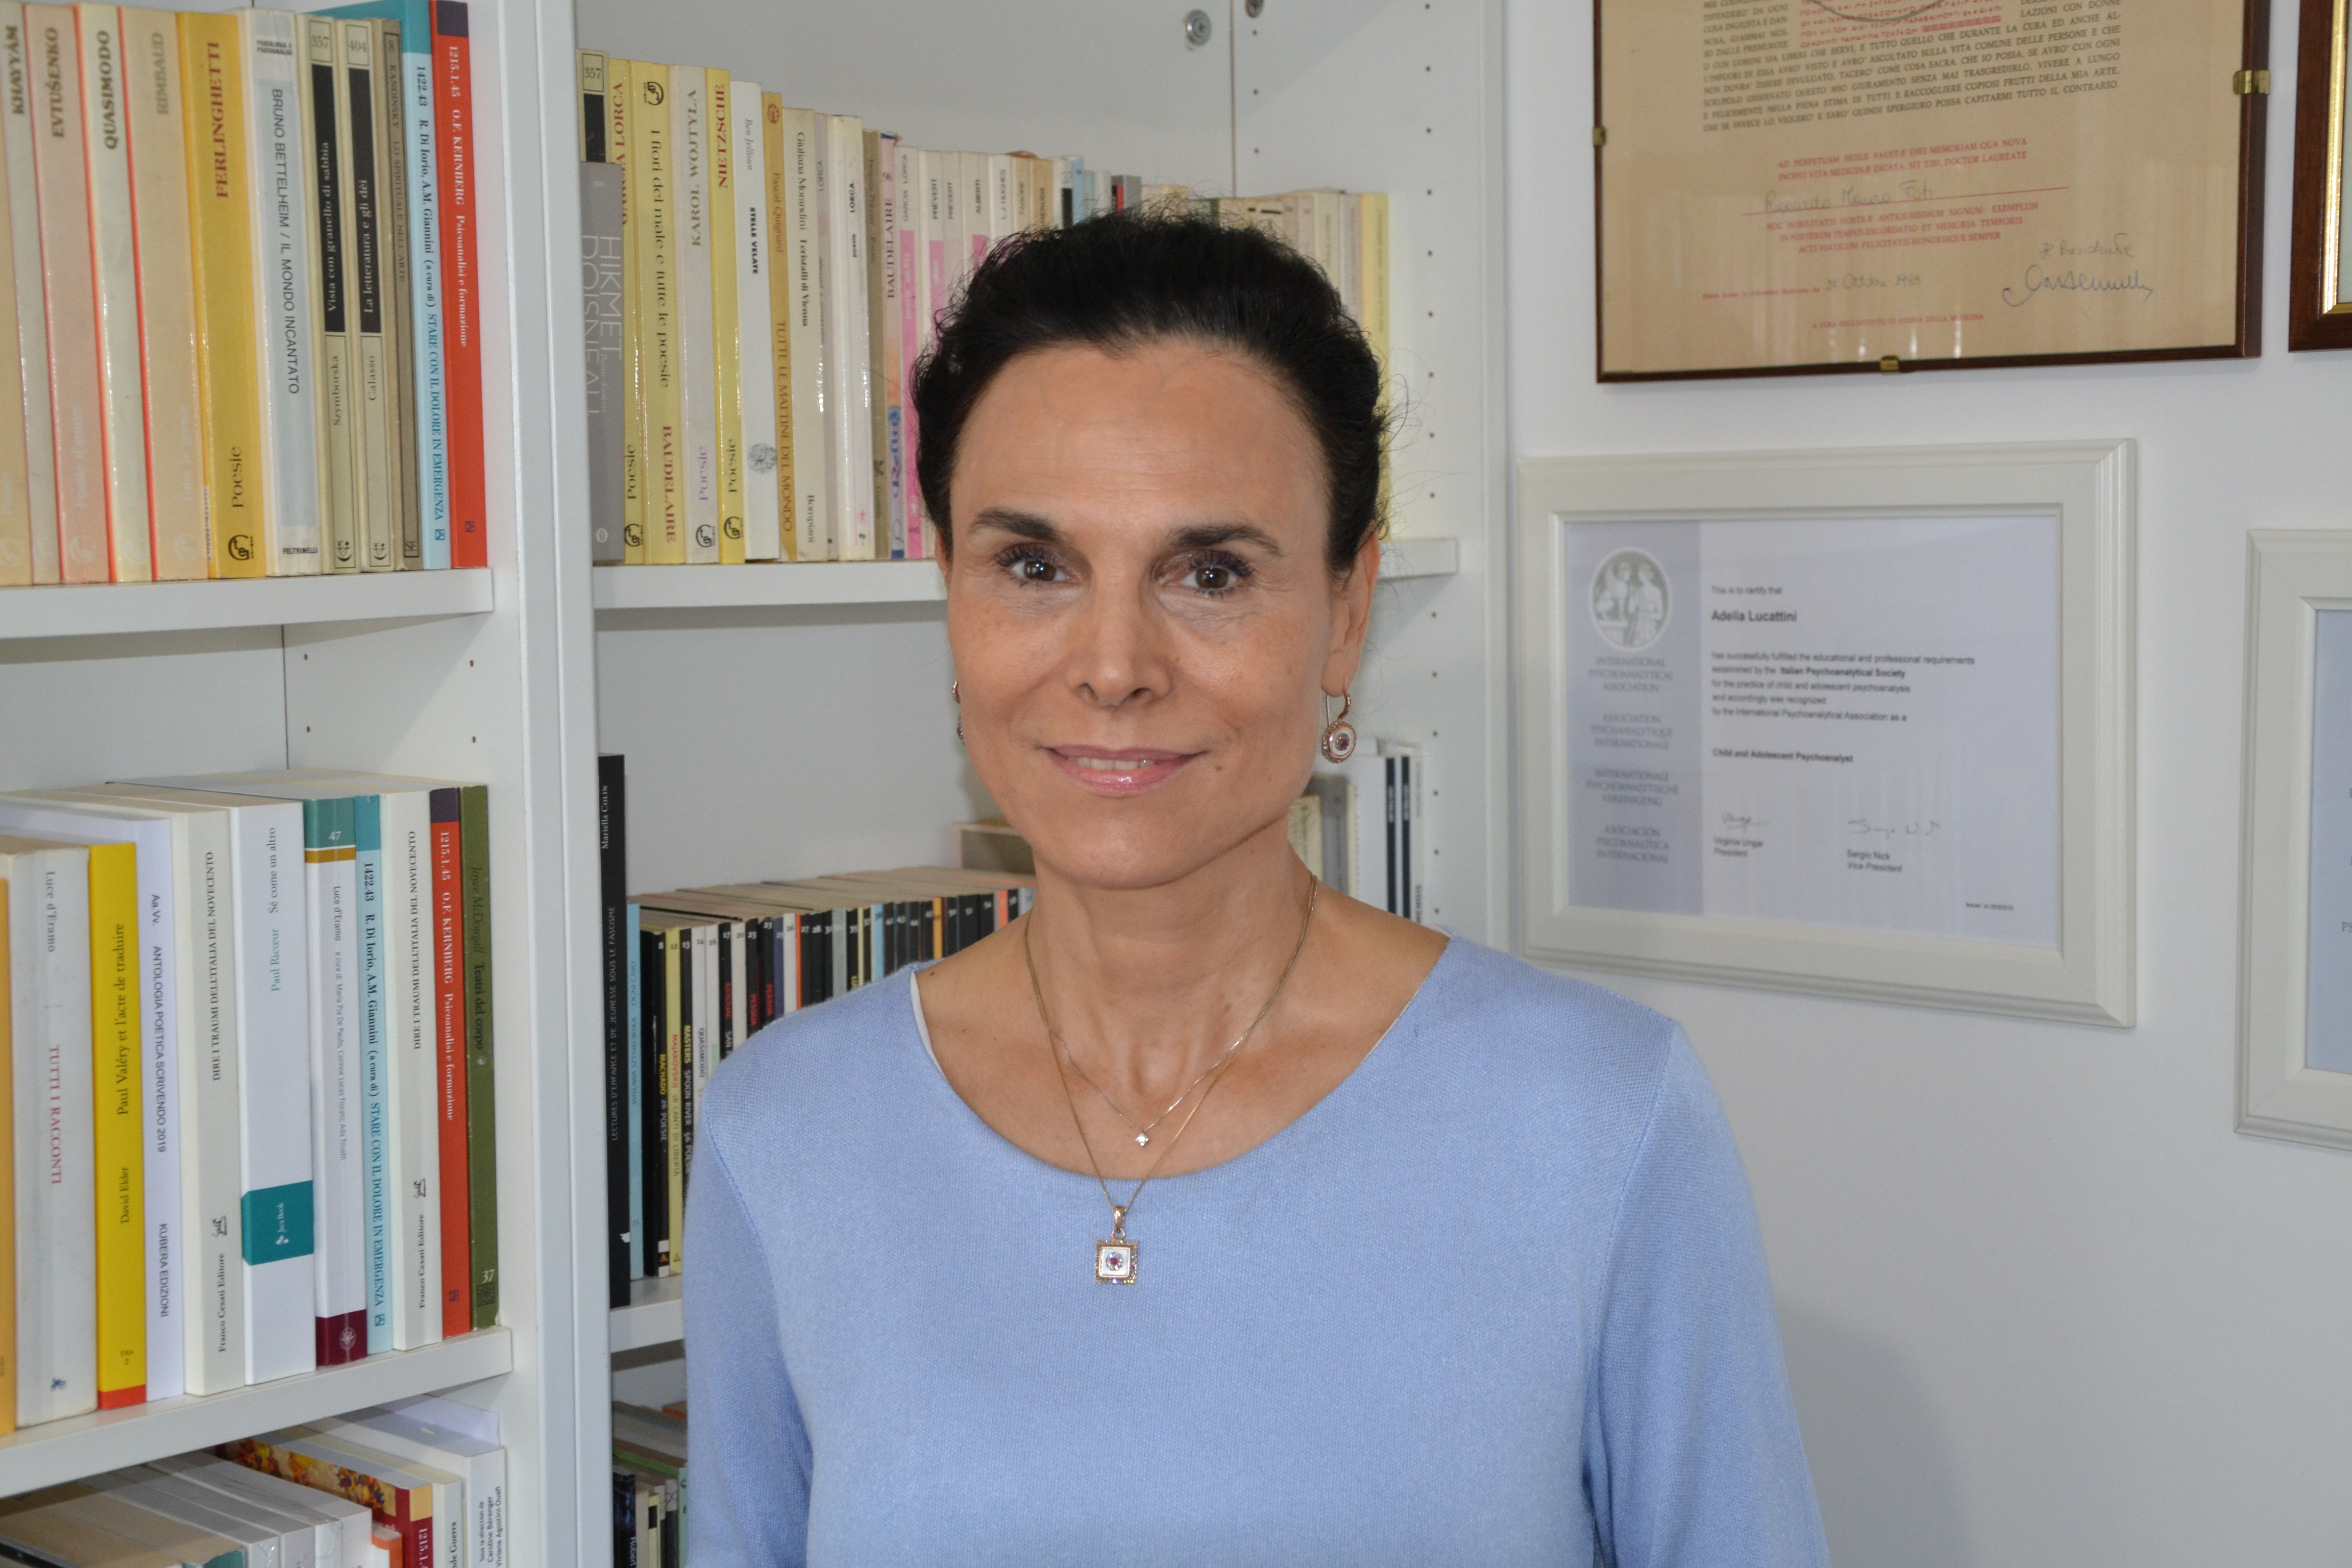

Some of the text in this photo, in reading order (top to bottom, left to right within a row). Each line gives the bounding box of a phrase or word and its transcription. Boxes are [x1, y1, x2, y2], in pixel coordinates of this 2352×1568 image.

[311, 36, 329, 48] 357
[348, 39, 367, 51] 404
[95, 30, 118, 149] QUASIMODO
[150, 31, 169, 114] RIMBAUD
[416, 65, 428, 107] 1422.43
[449, 46, 461, 97] 1215.1.45
[584, 68, 601, 79] 357
[2002, 76, 2035, 86] FRUTTI
[2038, 72, 2067, 83] DELLA
[2071, 70, 2089, 79] MIA
[2016, 88, 2046, 99] TUTTO
[2050, 87, 2059, 95] IL
[206, 41, 228, 198] FERLINGHETTI
[419, 119, 428, 130] R.
[451, 109, 462, 132] O.F.
[612, 82, 625, 147] LORCA
[420, 133, 430, 145] Di
[715, 84, 728, 188] NIETZSCHE
[2001, 137, 2027, 148] NOVA
[419, 148, 431, 178] Iorio,
[452, 136, 464, 205] KERNBERG
[651, 140, 663, 172] fiori
[421, 181, 432, 205] A.M.
[653, 177, 664, 202] del
[320, 141, 336, 311] Vista con granello di sabbia
[359, 202, 372, 217] gli
[689, 183, 701, 247] KAROL
[271, 88, 299, 394] BRUNO BETTELHEIM IL MONDO INCANTATO
[423, 208, 434, 254] Giannini
[455, 215, 467, 277] Psicoanalisi
[654, 208, 666, 249] male
[360, 232, 373, 294] letteratura
[656, 254, 664, 264] e
[884, 198, 896, 298] BAUDELAIRE
[425, 272, 433, 294] cura
[600, 236, 621, 360] HIKMET
[656, 271, 667, 306] tutte
[363, 298, 374, 313] La
[458, 287, 469, 347] formazione
[658, 312, 668, 327] le
[427, 313, 438, 348] STARE
[367, 355, 377, 401] Calasso
[428, 351, 439, 374] CON
[656, 332, 669, 388] poesie
[330, 355, 343, 426] Szymborska
[429, 378, 439, 388] IL
[429, 390, 442, 436] DOLORE
[777, 323, 792, 532] TUTTE LE MATTINE DEL MONDO
[432, 438, 443, 450] IN
[228, 446, 244, 508] Poesie
[697, 446, 708, 501] Poesie
[727, 438, 737, 493] Poesie
[432, 453, 445, 521] EMERGENZA
[662, 426, 676, 543] BAUDELAIRE
[1711, 610, 1797, 621] Adelia Lucattini
[1875, 670, 1905, 679] Society
[1713, 749, 1732, 757] Child
[1734, 750, 1749, 758] and
[1751, 750, 1794, 760] Adolescent
[267, 827, 276, 851] altro
[329, 831, 341, 840] 47
[270, 854, 277, 867] un
[205, 851, 215, 917] NOVECENTO
[45, 871, 56, 953] Luce d'Eramo
[268, 900, 278, 914] Sé
[112, 923, 125, 972] traduire
[207, 919, 216, 940] DEL
[609, 947, 616, 957] LE
[114, 976, 126, 990] de
[153, 946, 162, 1010] ANTOLOGIA
[208, 942, 218, 1004] DELL'ITALIA
[271, 969, 281, 991] Paul
[118, 1030, 126, 1041] et
[154, 1012, 164, 1059] POETICA
[210, 1006, 219, 1046] TRAUMI
[610, 1027, 617, 1038] DE
[115, 1045, 130, 1084] Valéry
[610, 1041, 617, 1051] ET
[48, 1044, 60, 1090] TUTTI
[211, 1055, 221, 1081] DIRE
[658, 1054, 667, 1095] MACHADO
[116, 1088, 129, 1115] Paul
[155, 1061, 165, 1126] SCRIVENDO
[660, 1099, 667, 1110] 26
[50, 1107, 62, 1185] RACCONTI
[157, 1129, 166, 1153] 2019
[119, 1167, 130, 1223] David Elder
[159, 1223, 168, 1317] KUBERA EDIZIONI
[483, 1270, 495, 1283] 37
